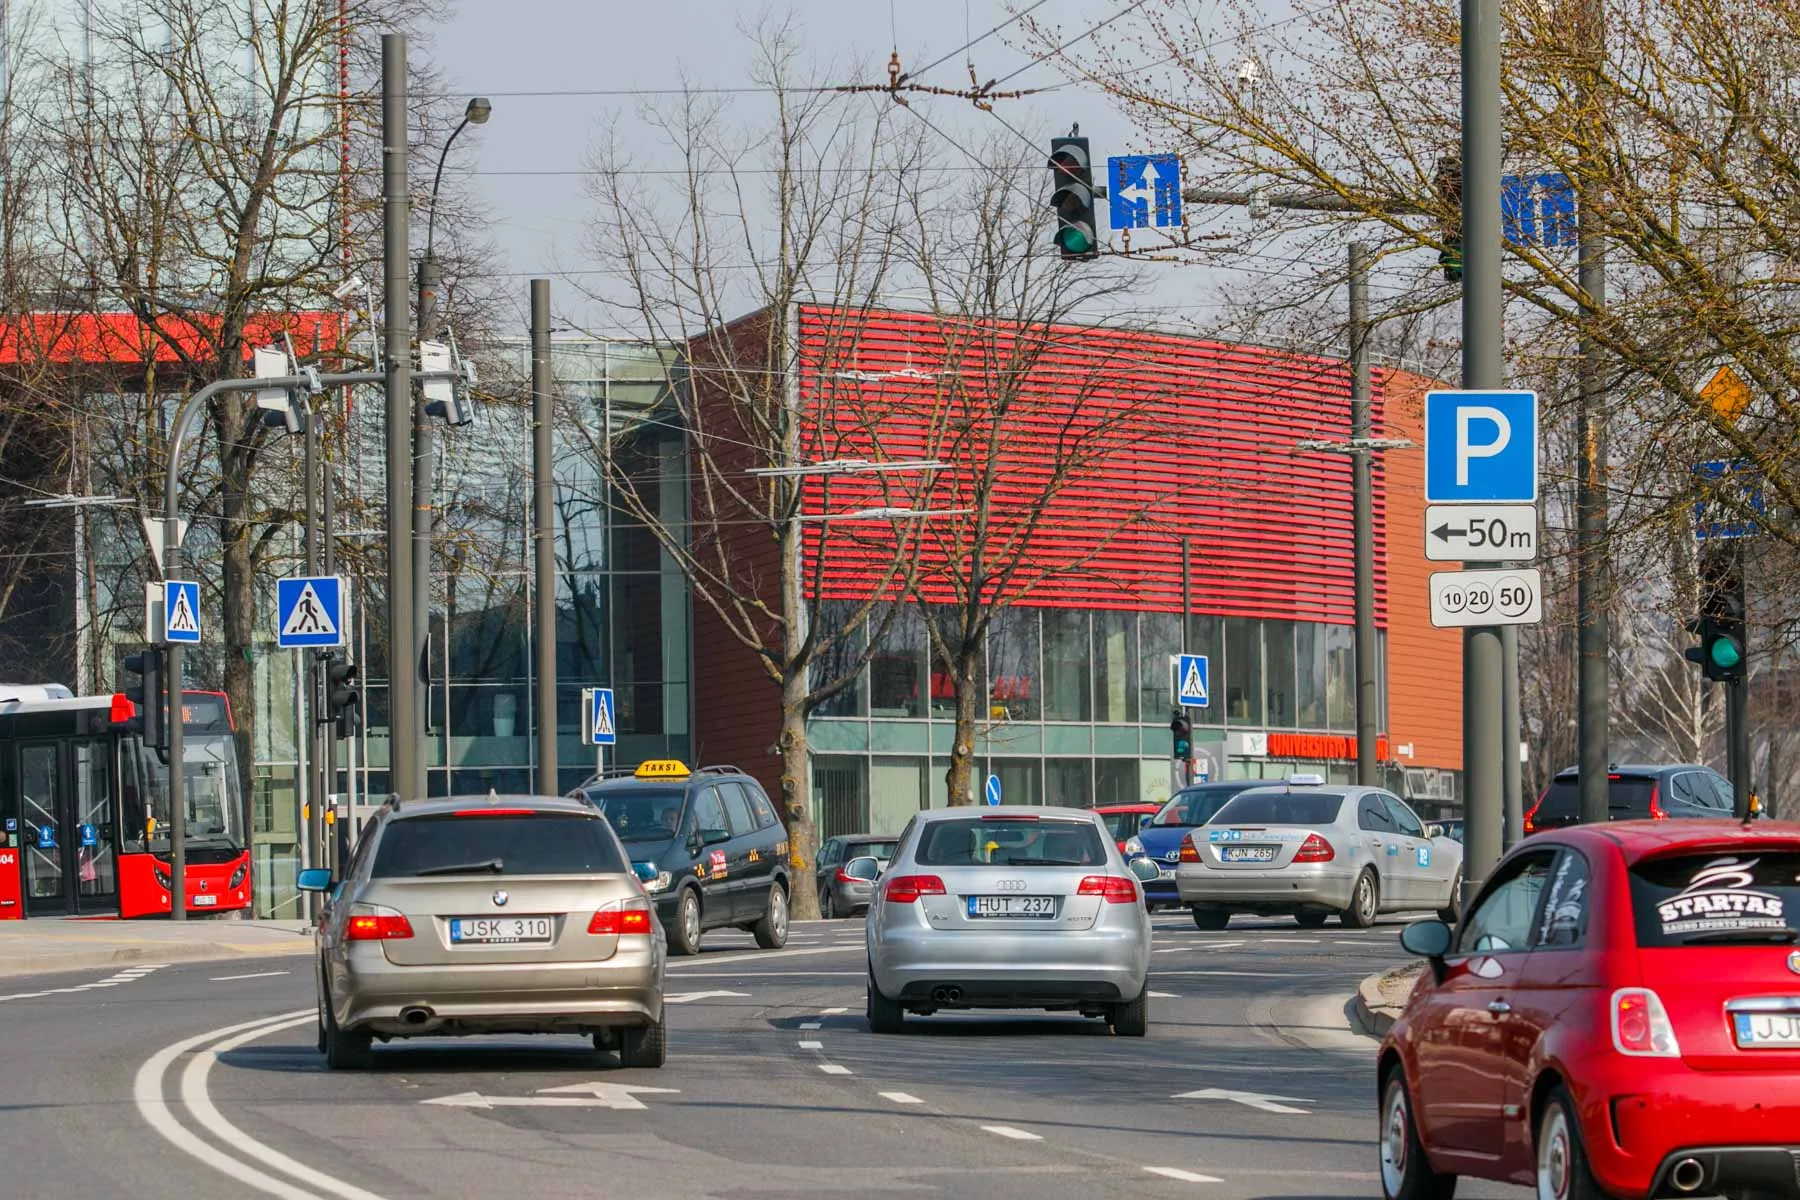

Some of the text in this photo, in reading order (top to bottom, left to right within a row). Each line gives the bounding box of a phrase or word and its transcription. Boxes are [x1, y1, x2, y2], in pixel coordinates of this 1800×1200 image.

[1456, 406, 1512, 486] P
[1444, 587, 1526, 606] 10 20 50
[645, 763, 677, 772] TAKSI
[0, 854, 14, 865] 04
[1228, 848, 1271, 858] KJN 265
[978, 898, 1051, 912] HUT 237
[1657, 894, 1783, 922] STARTAS
[464, 920, 546, 936] JSK 310
